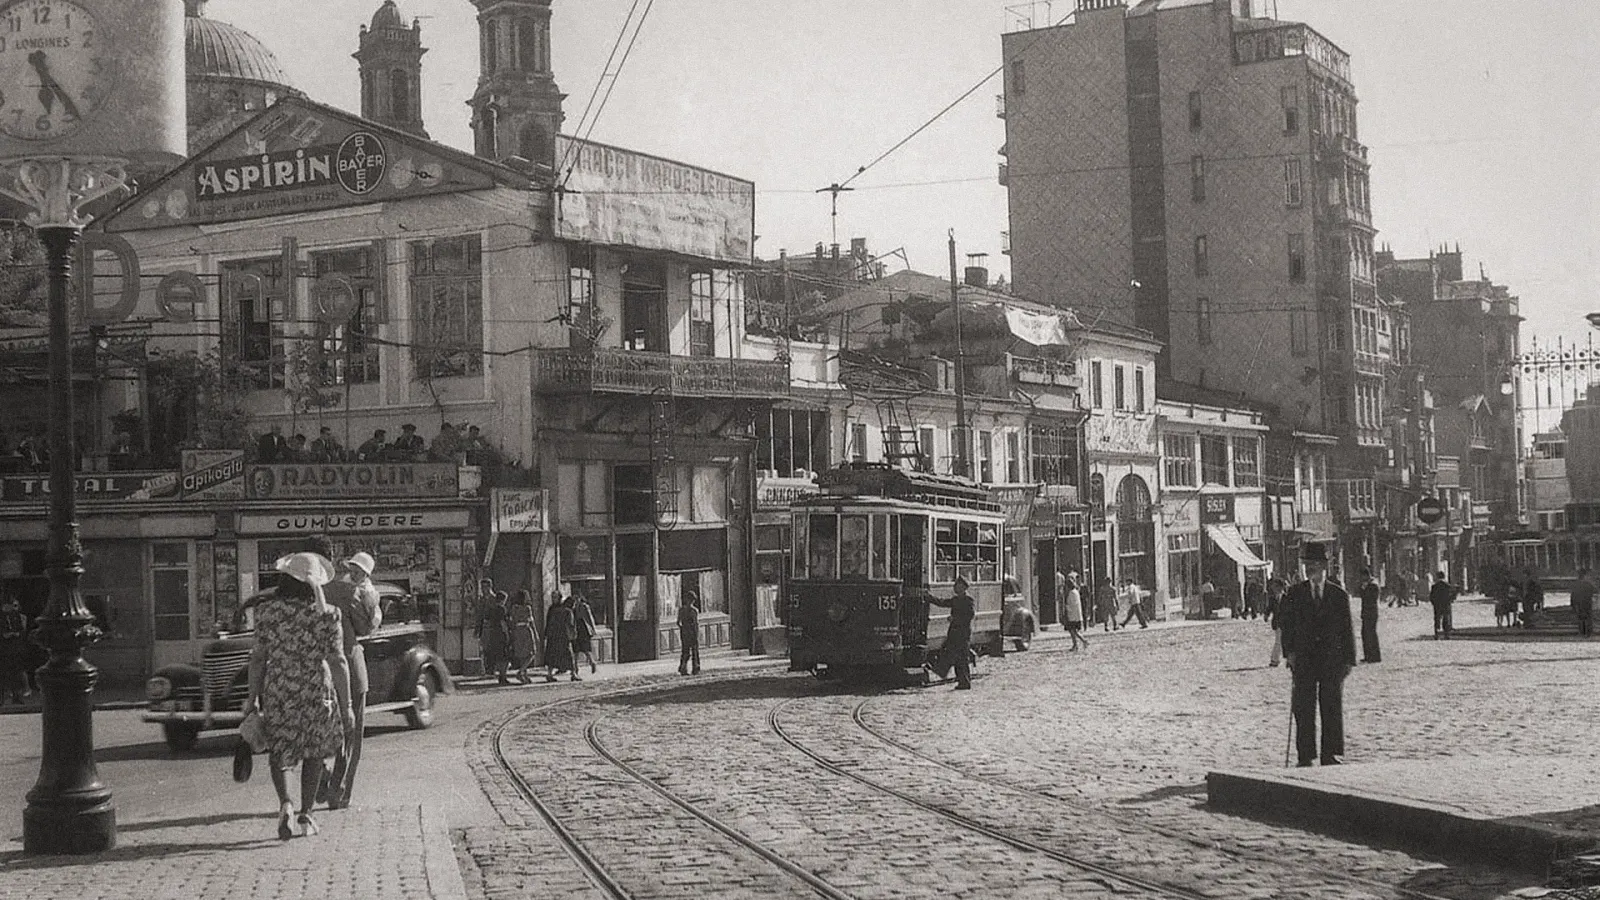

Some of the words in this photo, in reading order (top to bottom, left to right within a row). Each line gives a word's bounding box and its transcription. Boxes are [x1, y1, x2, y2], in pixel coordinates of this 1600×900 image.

[33, 6, 51, 24] 12
[65, 13, 71, 29] 1
[9, 16, 21, 32] 11
[15, 36, 71, 50] LONGINES
[82, 30, 94, 48] 2
[35, 114, 51, 131] 6
[339, 154, 384, 172] BAYER
[354, 135, 367, 191] BAYER
[878, 595, 896, 610] 135
